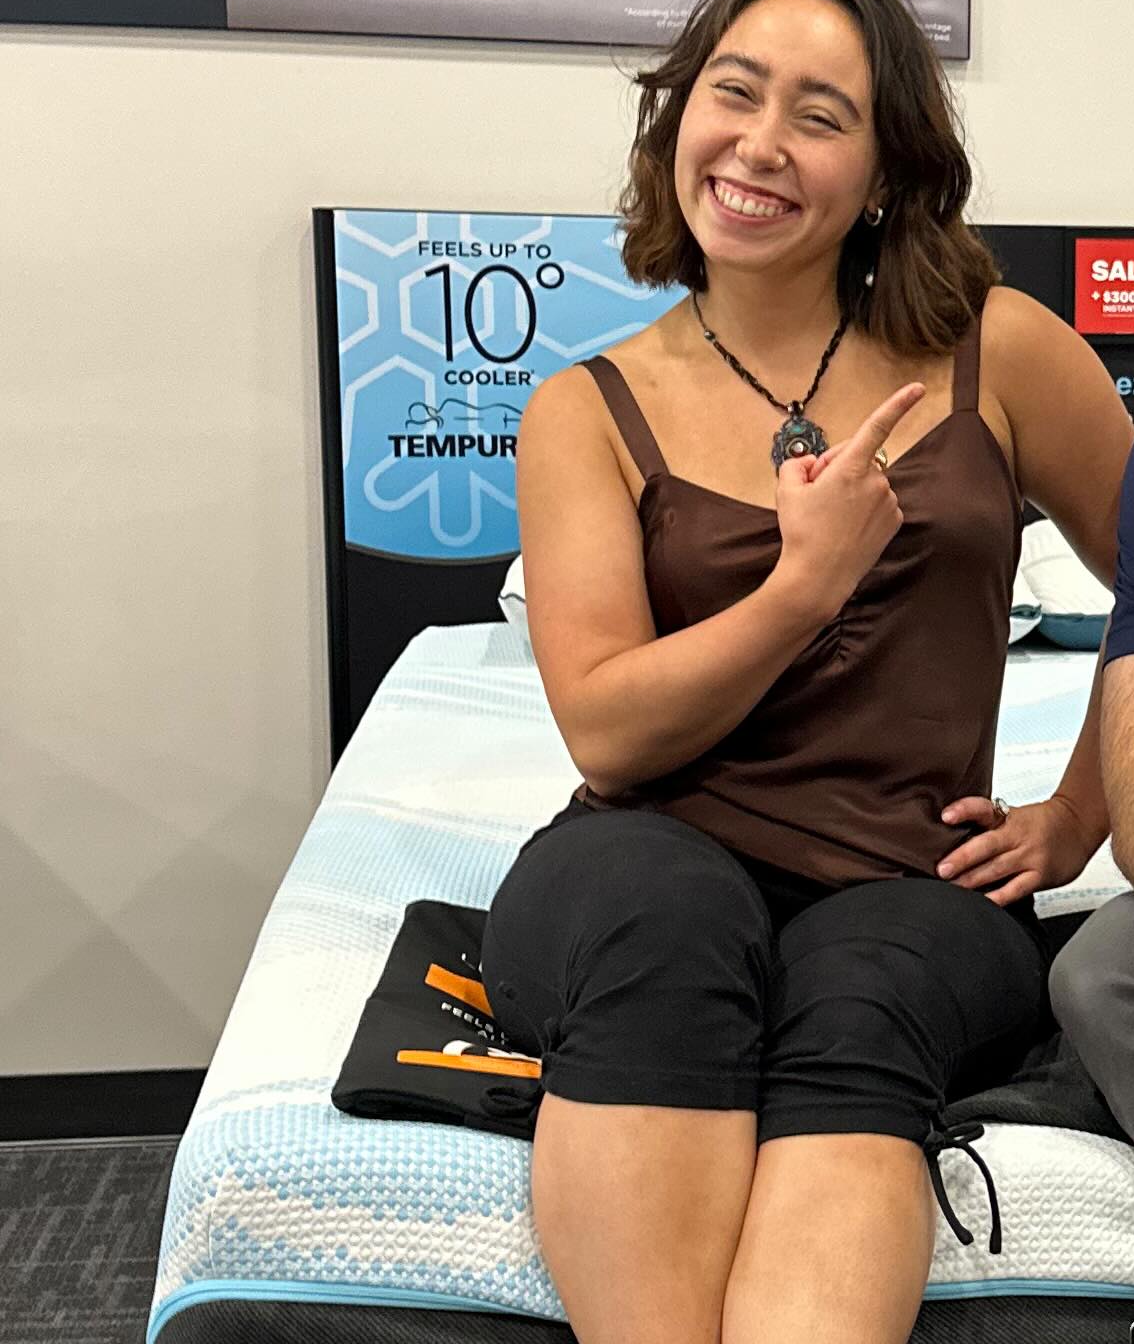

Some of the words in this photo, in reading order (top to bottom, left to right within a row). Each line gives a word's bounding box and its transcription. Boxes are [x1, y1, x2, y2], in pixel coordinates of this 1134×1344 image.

[418, 240, 483, 258] FEELS
[489, 242, 517, 258] UP
[523, 243, 552, 260] TO
[387, 434, 517, 457] TEMPUR
